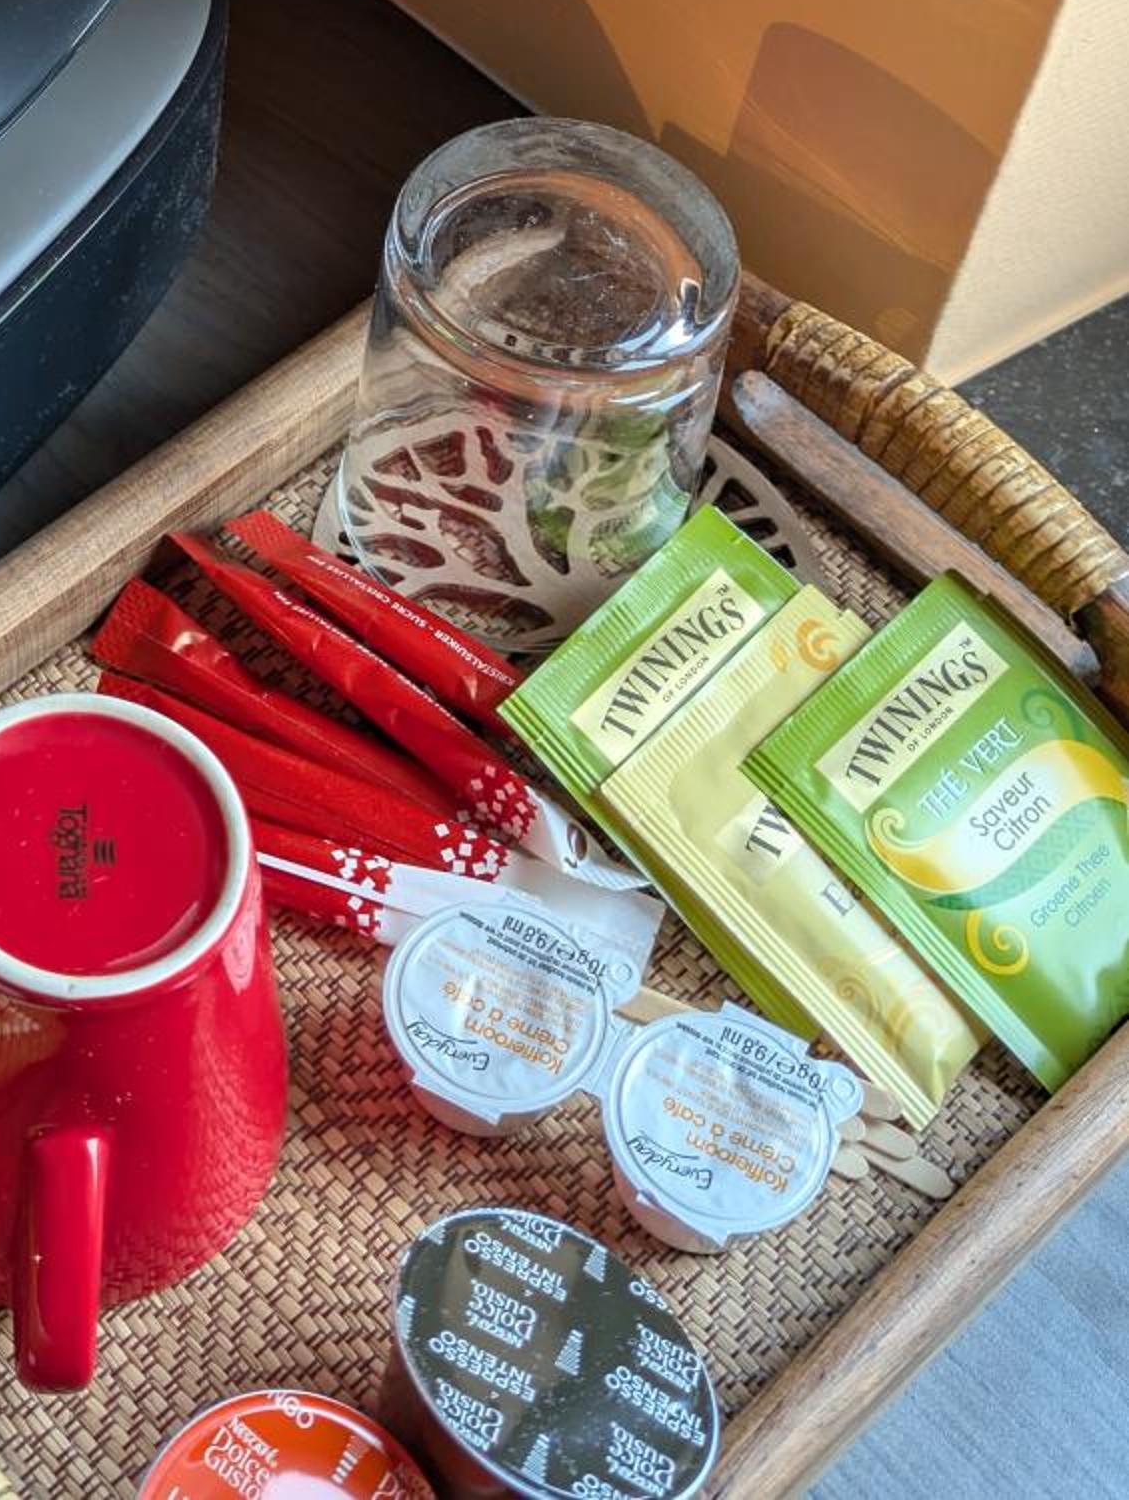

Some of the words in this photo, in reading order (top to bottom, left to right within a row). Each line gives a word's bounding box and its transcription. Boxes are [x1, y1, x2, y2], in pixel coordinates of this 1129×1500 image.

[600, 597, 746, 738] TWININGS
[677, 656, 710, 691] LONDON
[845, 650, 989, 787] TWININGS
[907, 738, 920, 752] OF
[923, 706, 954, 740] LONDON
[959, 716, 1025, 775] VERT
[969, 771, 1035, 837] Saveur
[993, 794, 1052, 851] Citron
[406, 1020, 491, 1072] Everyday
[464, 1015, 564, 1076] Koffieroom
[627, 1134, 714, 1191] Everyday
[686, 1129, 789, 1194] Koffieroom
[464, 1238, 568, 1302] ESPRESSO
[475, 1232, 564, 1286] INTENSO
[469, 1296, 534, 1341] Dolce
[427, 1337, 536, 1404] ESPRESSO
[439, 1330, 532, 1385] INTENSO
[638, 1341, 700, 1388] Dolce
[436, 1398, 501, 1445] Dolce
[604, 1372, 707, 1448] ESPRESSO
[616, 1365, 703, 1430] INTENSO
[203, 1445, 262, 1500] Gusto
[211, 1425, 270, 1486] Dolce
[608, 1443, 674, 1491] Dolce
